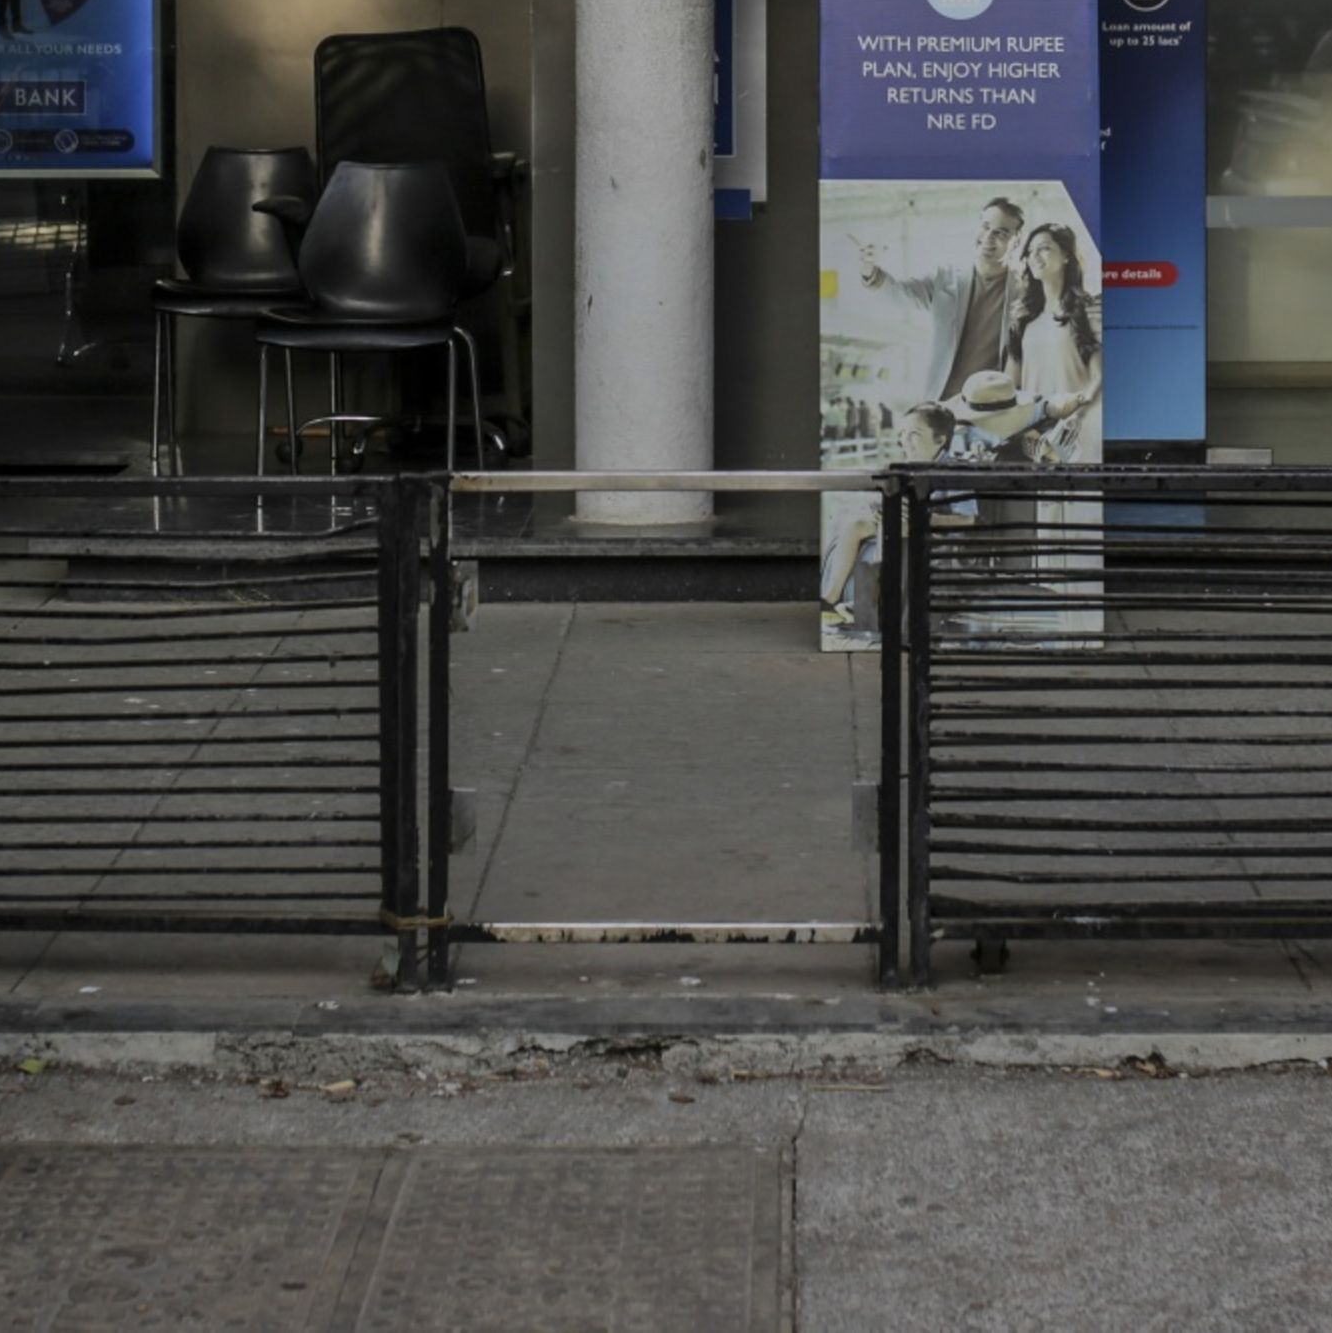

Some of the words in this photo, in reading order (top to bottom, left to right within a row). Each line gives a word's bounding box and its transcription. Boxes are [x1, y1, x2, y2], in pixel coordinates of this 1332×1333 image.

[1101, 21, 1130, 32] Loan
[1133, 22, 1176, 33] amount
[1179, 20, 1192, 33] of
[77, 42, 122, 55] NEEDS
[857, 36, 911, 52] WITH
[917, 36, 1001, 52] PREMIUM
[1007, 36, 1065, 53] RUPEE
[1110, 38, 1125, 48] up
[1126, 36, 1139, 46] to
[1142, 35, 1155, 46] 25
[862, 62, 917, 80] PLAN,
[923, 62, 983, 83] ENJOY
[988, 62, 1061, 78] HIGHER
[15, 87, 77, 107] BANK
[887, 88, 974, 104] RETURNS
[979, 88, 1036, 104] THAN
[927, 114, 965, 130] NRE
[971, 114, 997, 130] FD
[1121, 268, 1162, 280] details
